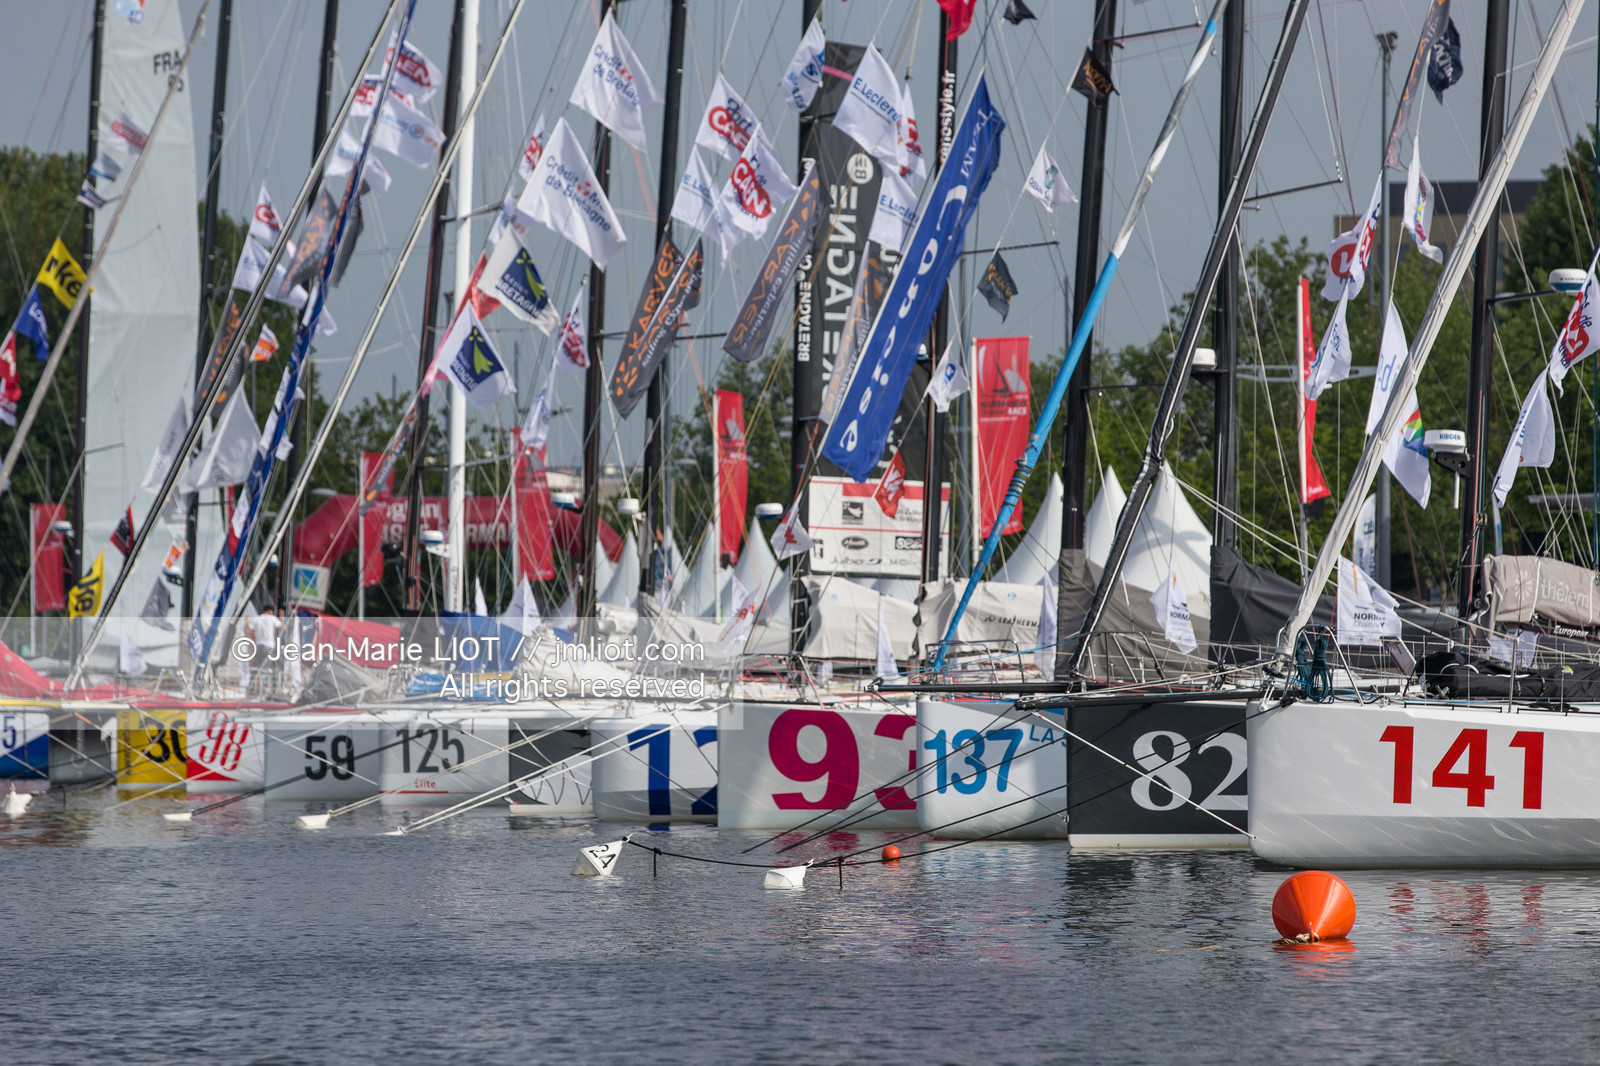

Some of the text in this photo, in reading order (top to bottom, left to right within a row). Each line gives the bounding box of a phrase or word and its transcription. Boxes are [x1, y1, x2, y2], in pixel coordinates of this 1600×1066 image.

[152, 49, 184, 75] FRA
[798, 281, 812, 362] BRETAGNE
[839, 184, 967, 452] Concise
[1541, 578, 1590, 609] thélem
[199, 710, 249, 772] 98
[304, 735, 356, 782] 59
[396, 722, 465, 774] 125
[924, 728, 1024, 795] 137
[1029, 724, 1055, 745] LA
[1131, 730, 1248, 812] 82
[1379, 724, 1545, 810] 141
